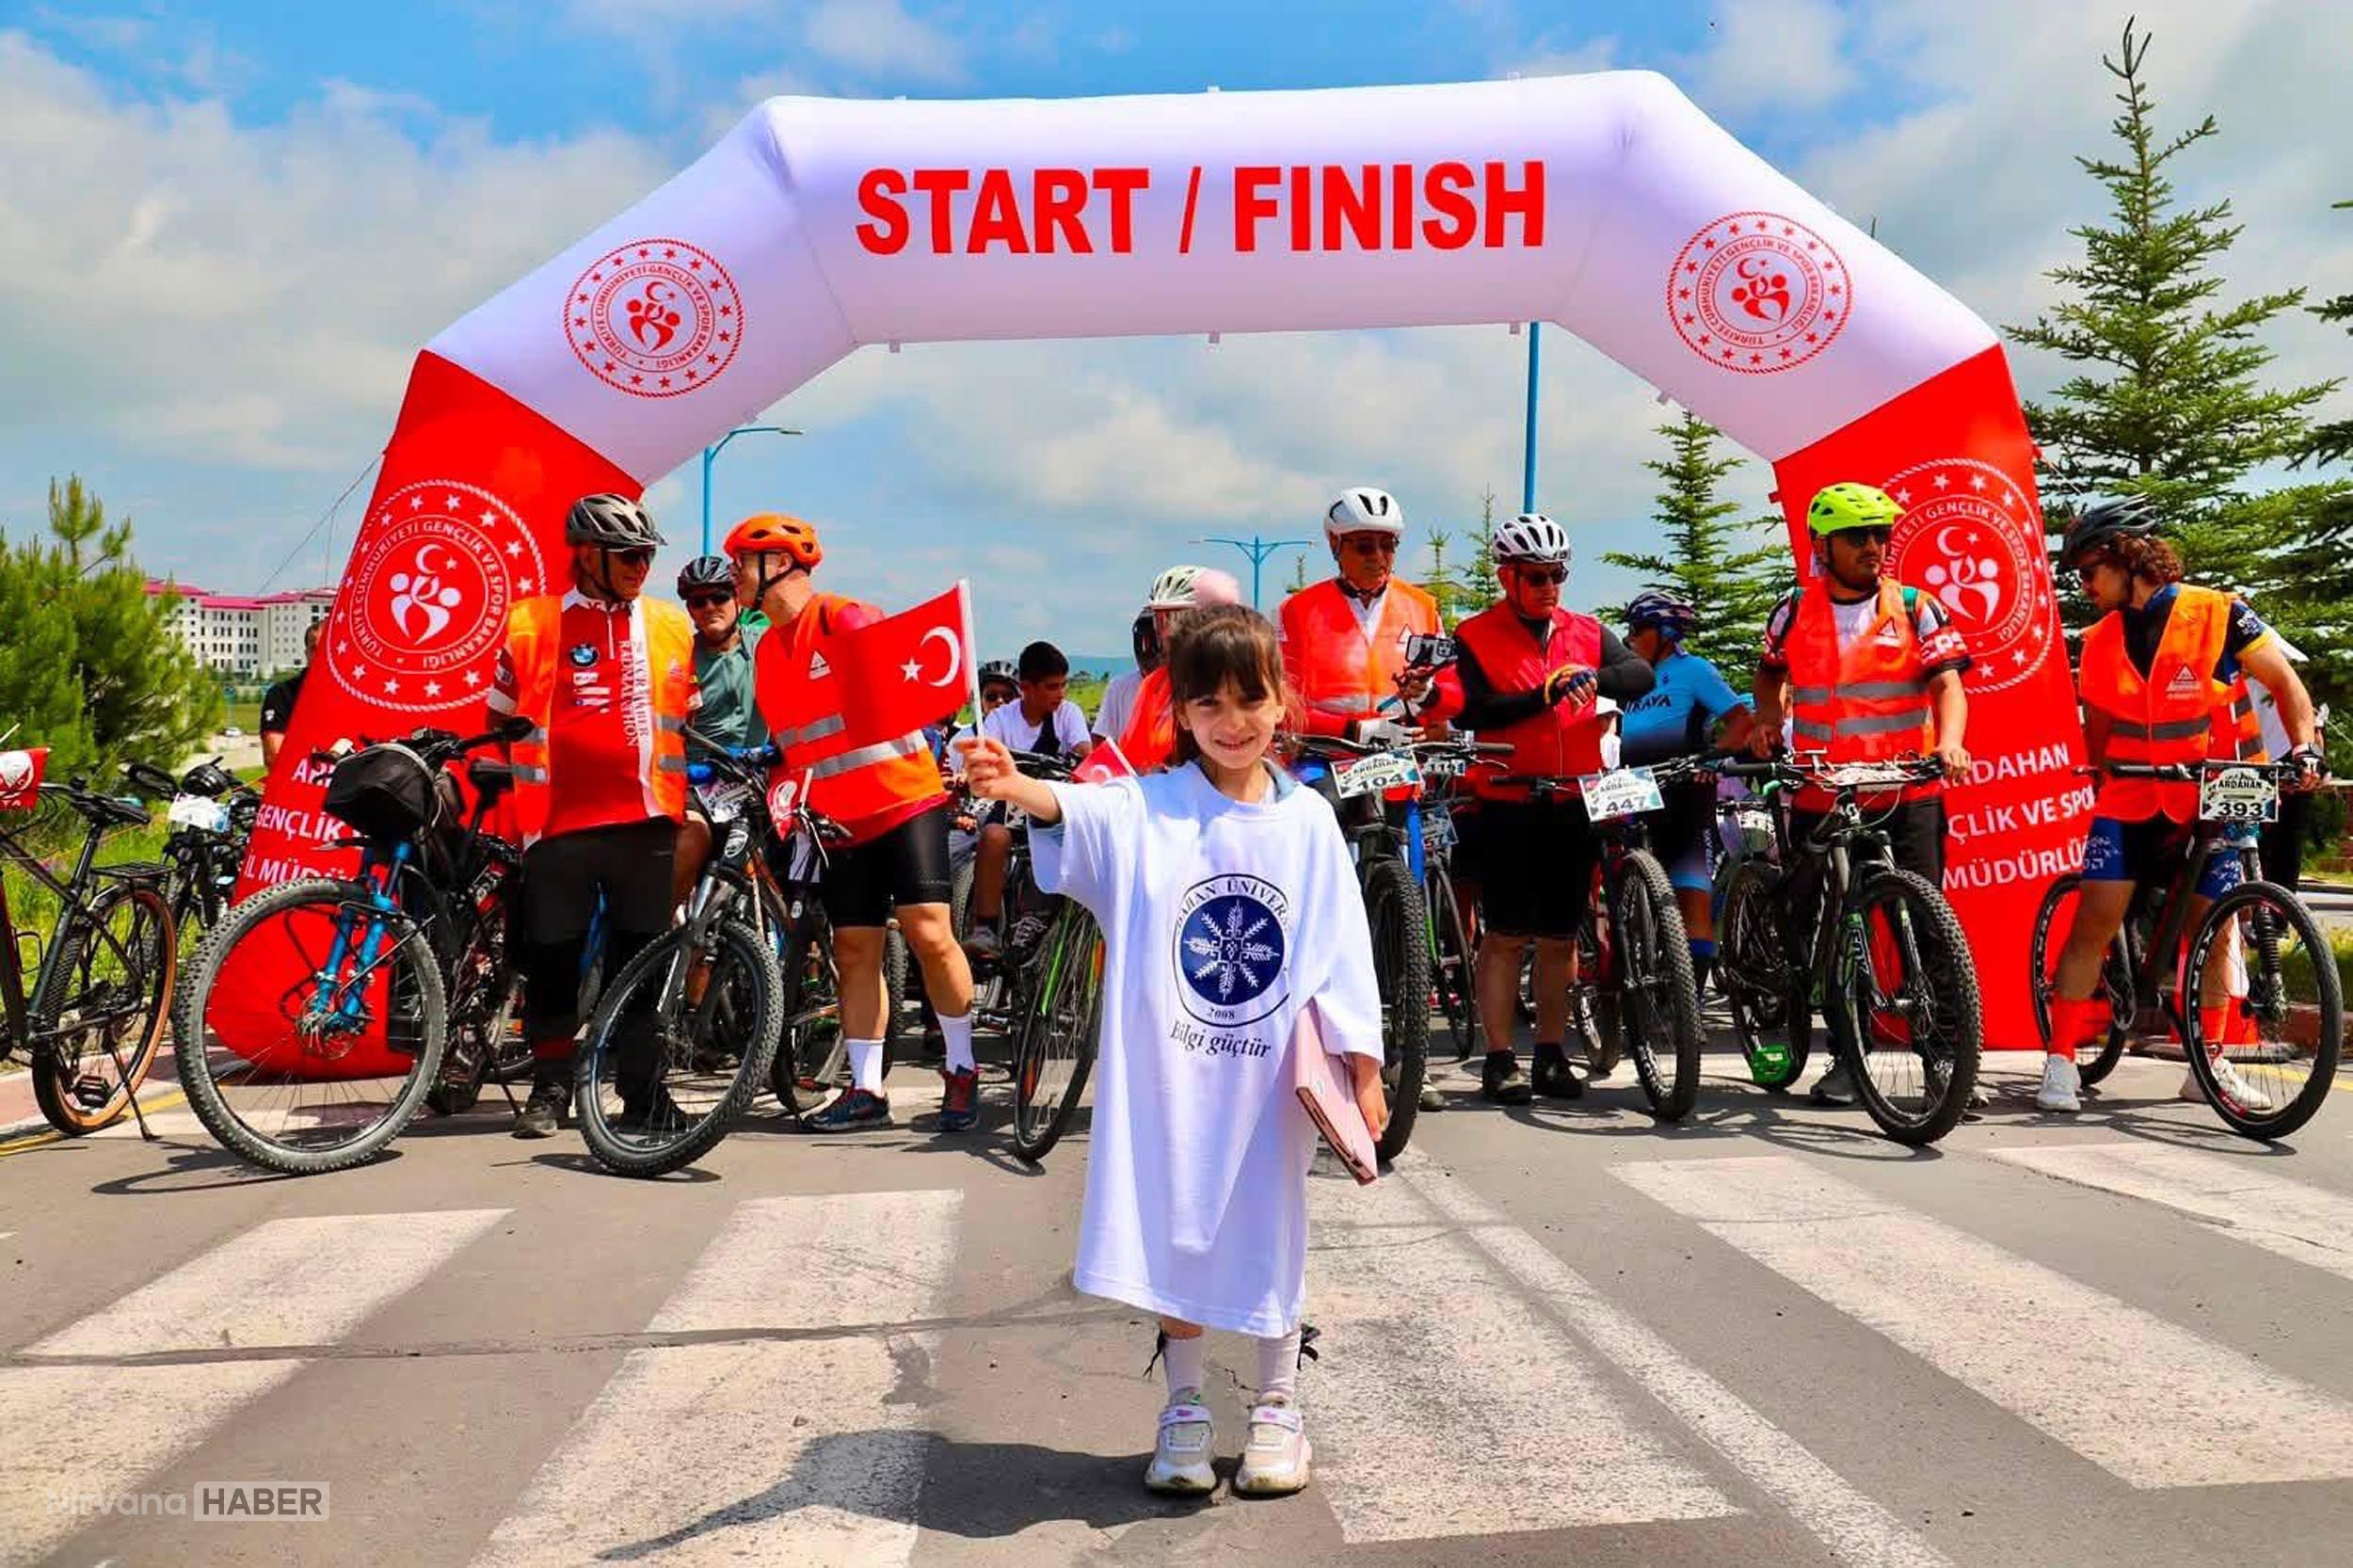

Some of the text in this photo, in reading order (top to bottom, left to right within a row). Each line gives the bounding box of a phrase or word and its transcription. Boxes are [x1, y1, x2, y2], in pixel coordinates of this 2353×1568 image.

[856, 161, 1545, 254] START / FINISH
[423, 520, 485, 553] GENÇLİK
[482, 554, 498, 572] VE
[489, 573, 504, 615] SPOR
[353, 604, 383, 658] TÜRKİYE
[423, 616, 498, 669] BAKANLIĞI
[1940, 743, 2070, 790] DAHAN
[2217, 780, 2263, 790] ARDAHAN
[256, 803, 347, 841] GENÇLİK
[1606, 795, 1646, 812] 447
[1948, 784, 2095, 845] ÇLİK VE SPO
[2217, 802, 2263, 816] 393
[1208, 1005, 1236, 1020] 2008
[1169, 1021, 1271, 1059] Bilgi güçtür
